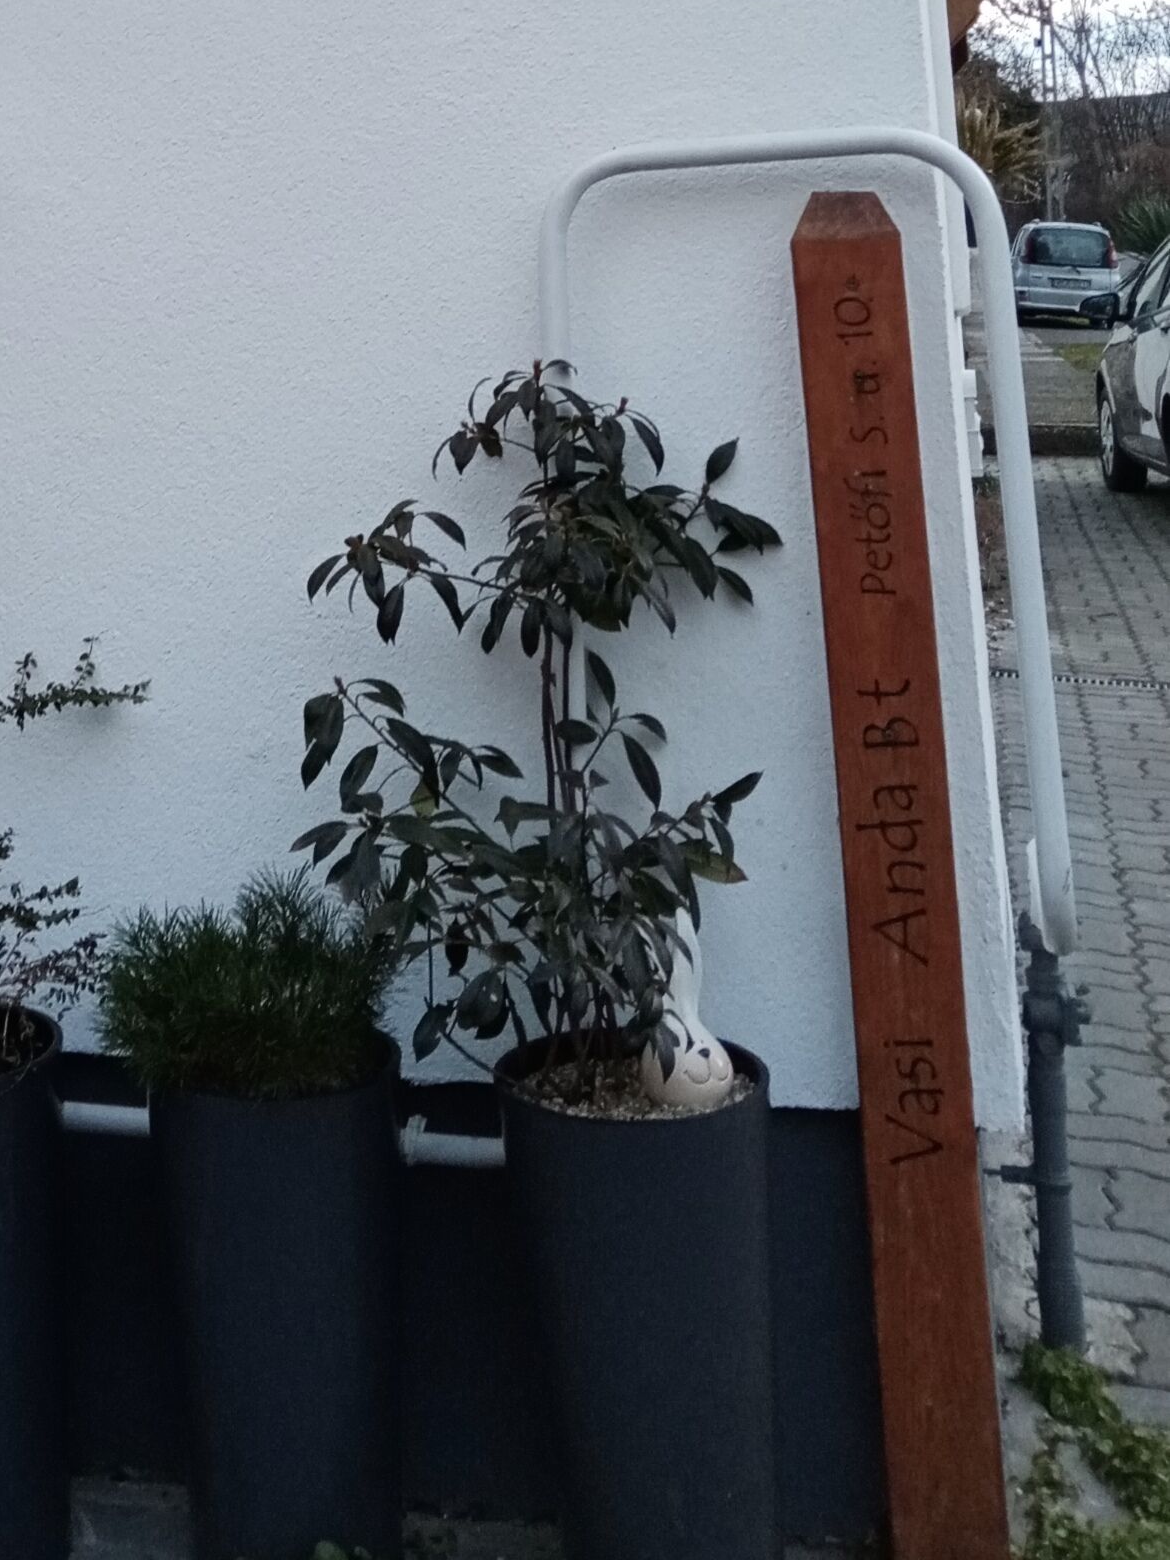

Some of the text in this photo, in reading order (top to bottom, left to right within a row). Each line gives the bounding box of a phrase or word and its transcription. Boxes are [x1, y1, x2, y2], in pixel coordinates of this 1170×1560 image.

[857, 677, 920, 748] Bt
[855, 784, 929, 967] Anda
[884, 1038, 944, 1166] Vasi
